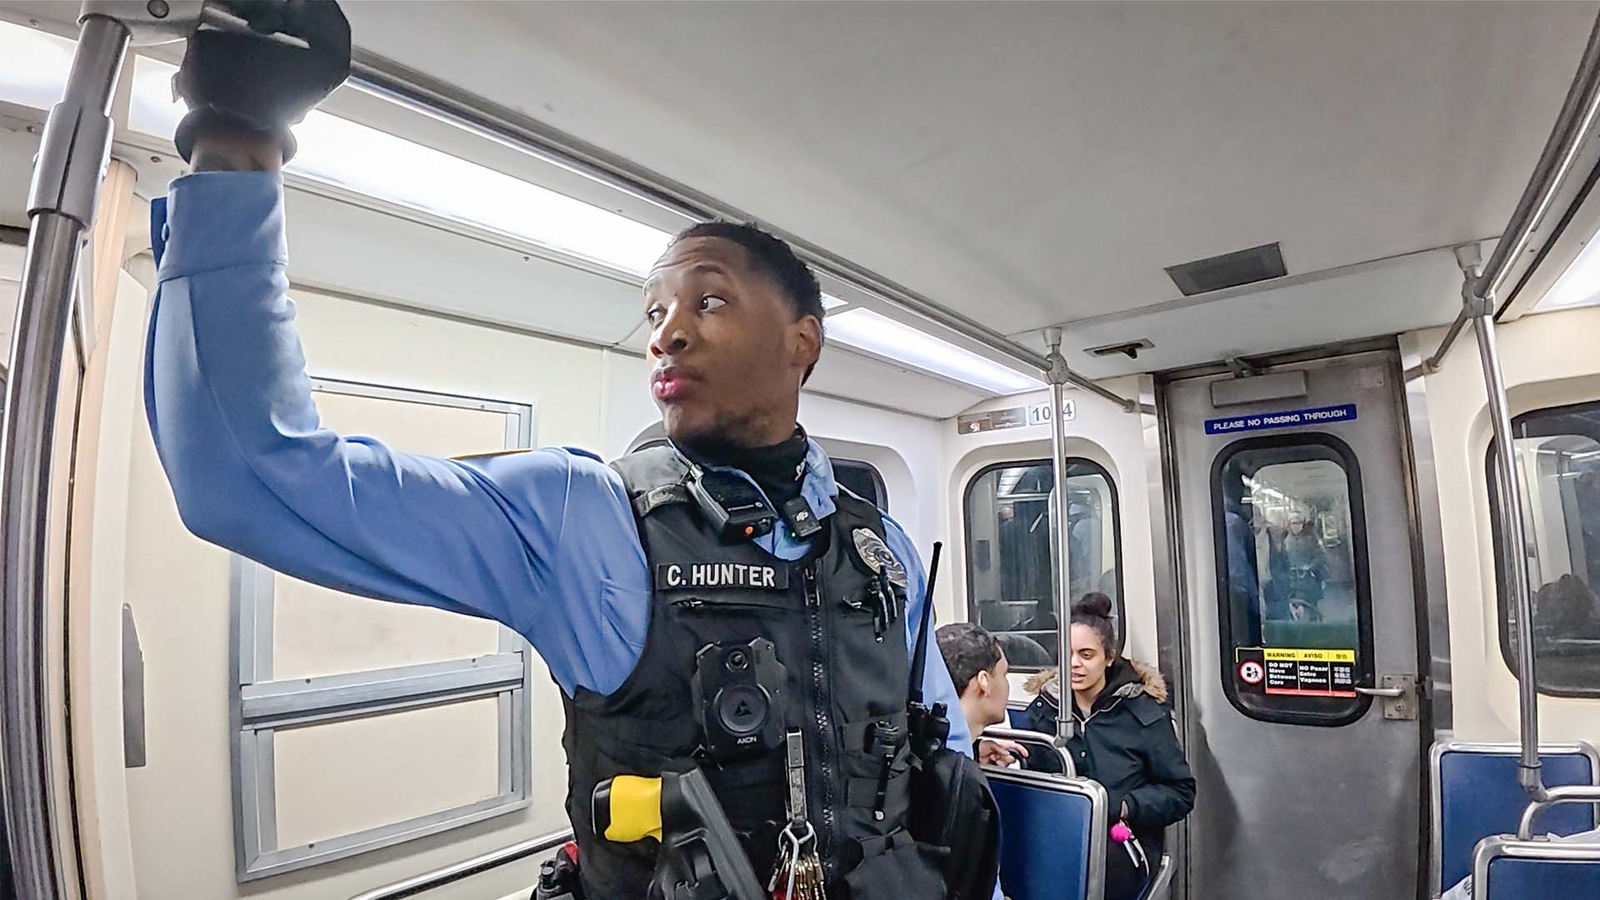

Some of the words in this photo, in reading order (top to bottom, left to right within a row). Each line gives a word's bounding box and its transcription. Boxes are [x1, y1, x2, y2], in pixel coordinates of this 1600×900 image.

[1032, 402, 1073, 422] 104
[1213, 419, 1245, 430] PLEASE
[1247, 418, 1261, 426] NO
[1263, 413, 1301, 425] PASSING
[1303, 409, 1347, 421] THROUGH
[667, 565, 687, 587] C.
[691, 563, 776, 588] HUNTER
[737, 736, 757, 744] AXON
